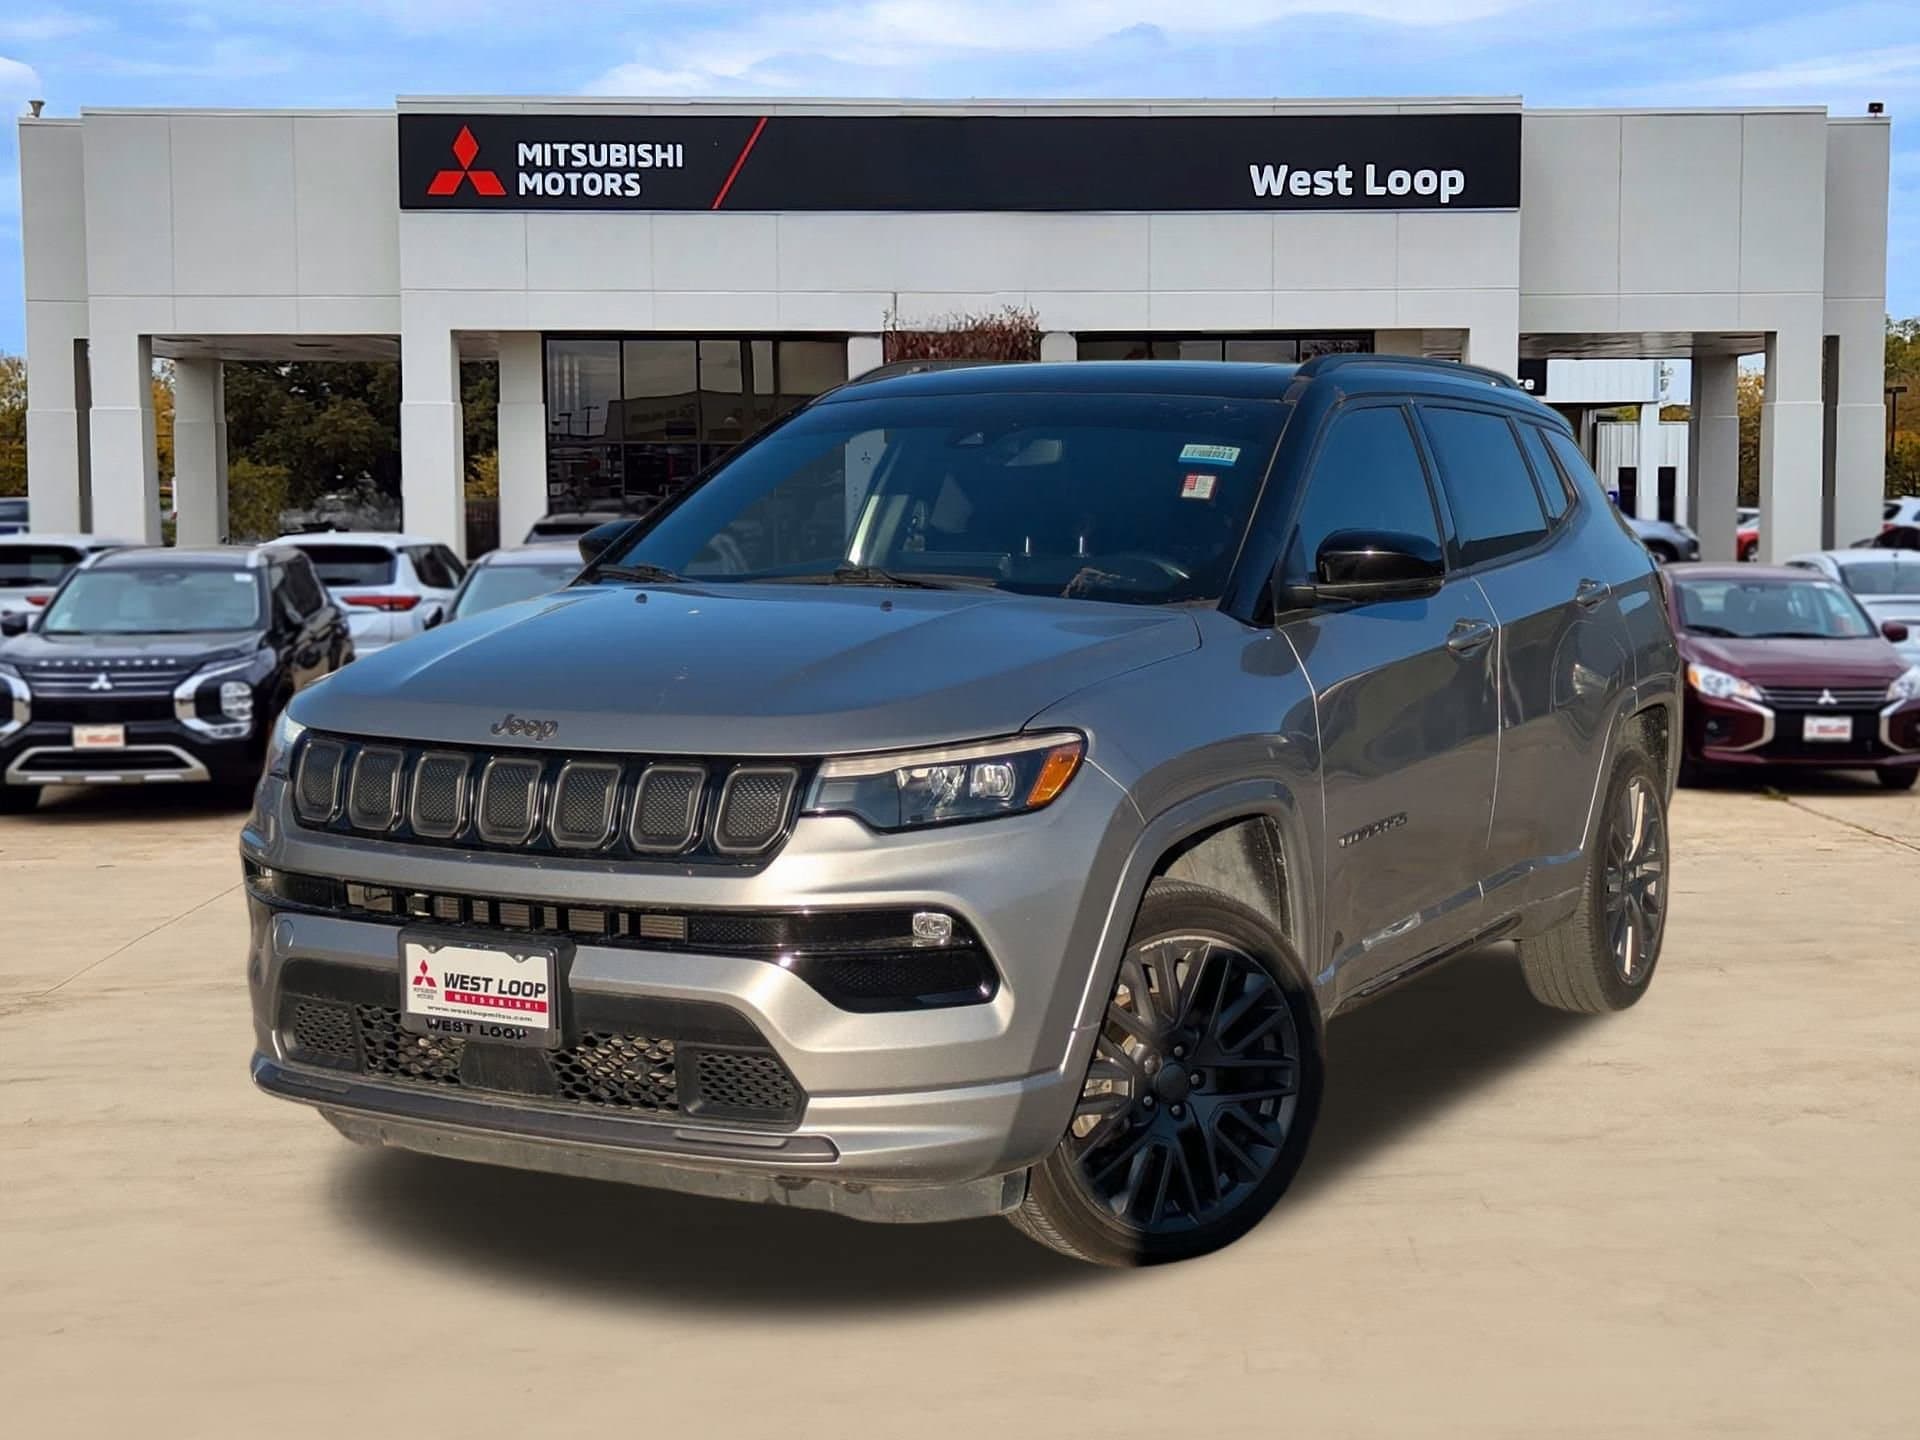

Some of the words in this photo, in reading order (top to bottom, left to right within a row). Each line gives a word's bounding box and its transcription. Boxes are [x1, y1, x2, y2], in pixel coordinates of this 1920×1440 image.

[517, 142, 684, 168] MITSUBISHI
[518, 172, 642, 198] MOTORS
[1249, 163, 1353, 196] West
[1365, 163, 1466, 204] Loop
[490, 713, 559, 742] Jeep
[444, 972, 493, 993] WEST
[498, 978, 547, 999] LOOP
[454, 993, 539, 1011] MITSUBISHI
[425, 1018, 473, 1034] WEST
[479, 1024, 529, 1040] LOOP
